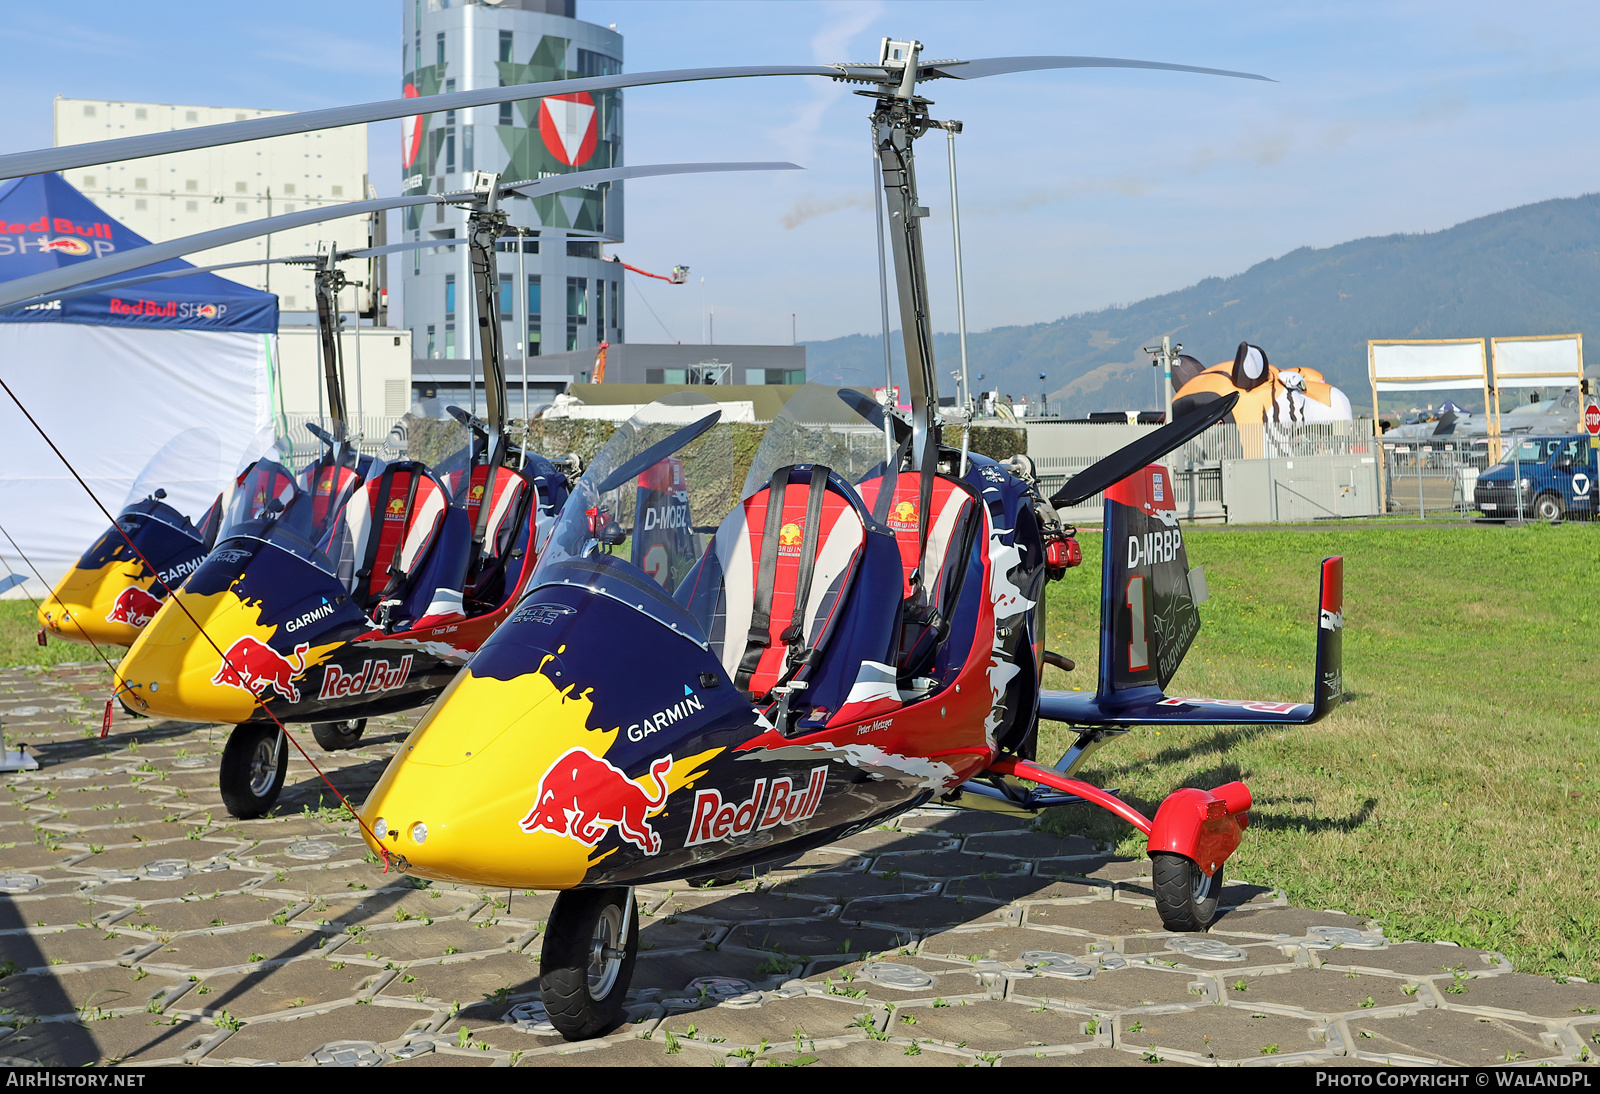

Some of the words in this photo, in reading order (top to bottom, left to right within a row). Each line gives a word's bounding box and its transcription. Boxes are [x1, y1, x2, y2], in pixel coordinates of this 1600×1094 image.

[53, 218, 113, 239] Bull
[110, 299, 144, 315] Red
[145, 301, 177, 317] Bull
[1585, 413, 1600, 426] STOP
[644, 505, 687, 531] D-MOBZ
[1127, 529, 1181, 569] D-MRBP
[285, 603, 335, 633] GARMIN
[1159, 611, 1197, 679] flugwelt.eu
[318, 659, 373, 701] Red
[364, 653, 414, 694] Bull
[627, 695, 704, 742] GARMIN
[856, 724, 872, 736] Peter
[683, 777, 767, 848] Red
[756, 764, 829, 832] Bull
